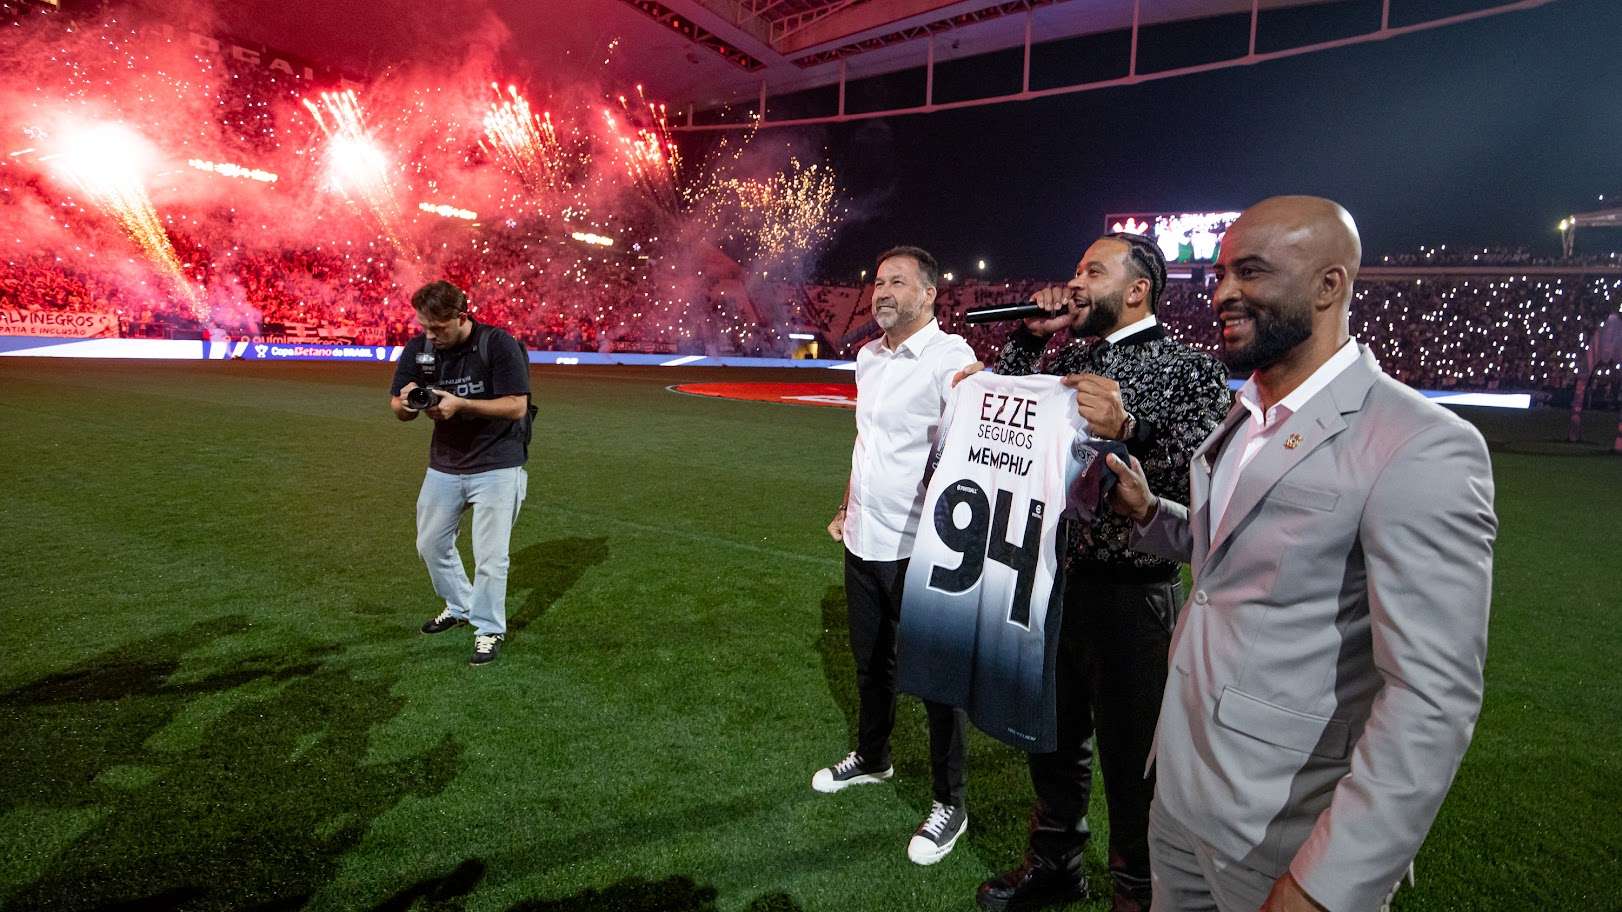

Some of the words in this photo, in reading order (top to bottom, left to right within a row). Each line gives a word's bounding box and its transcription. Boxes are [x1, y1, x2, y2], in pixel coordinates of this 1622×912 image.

[272, 347, 294, 358] Copa
[980, 393, 1037, 431] EZZE
[978, 424, 1033, 450] SEGUROS
[968, 445, 1033, 477] MEMPHIS
[927, 478, 1046, 632] 94
